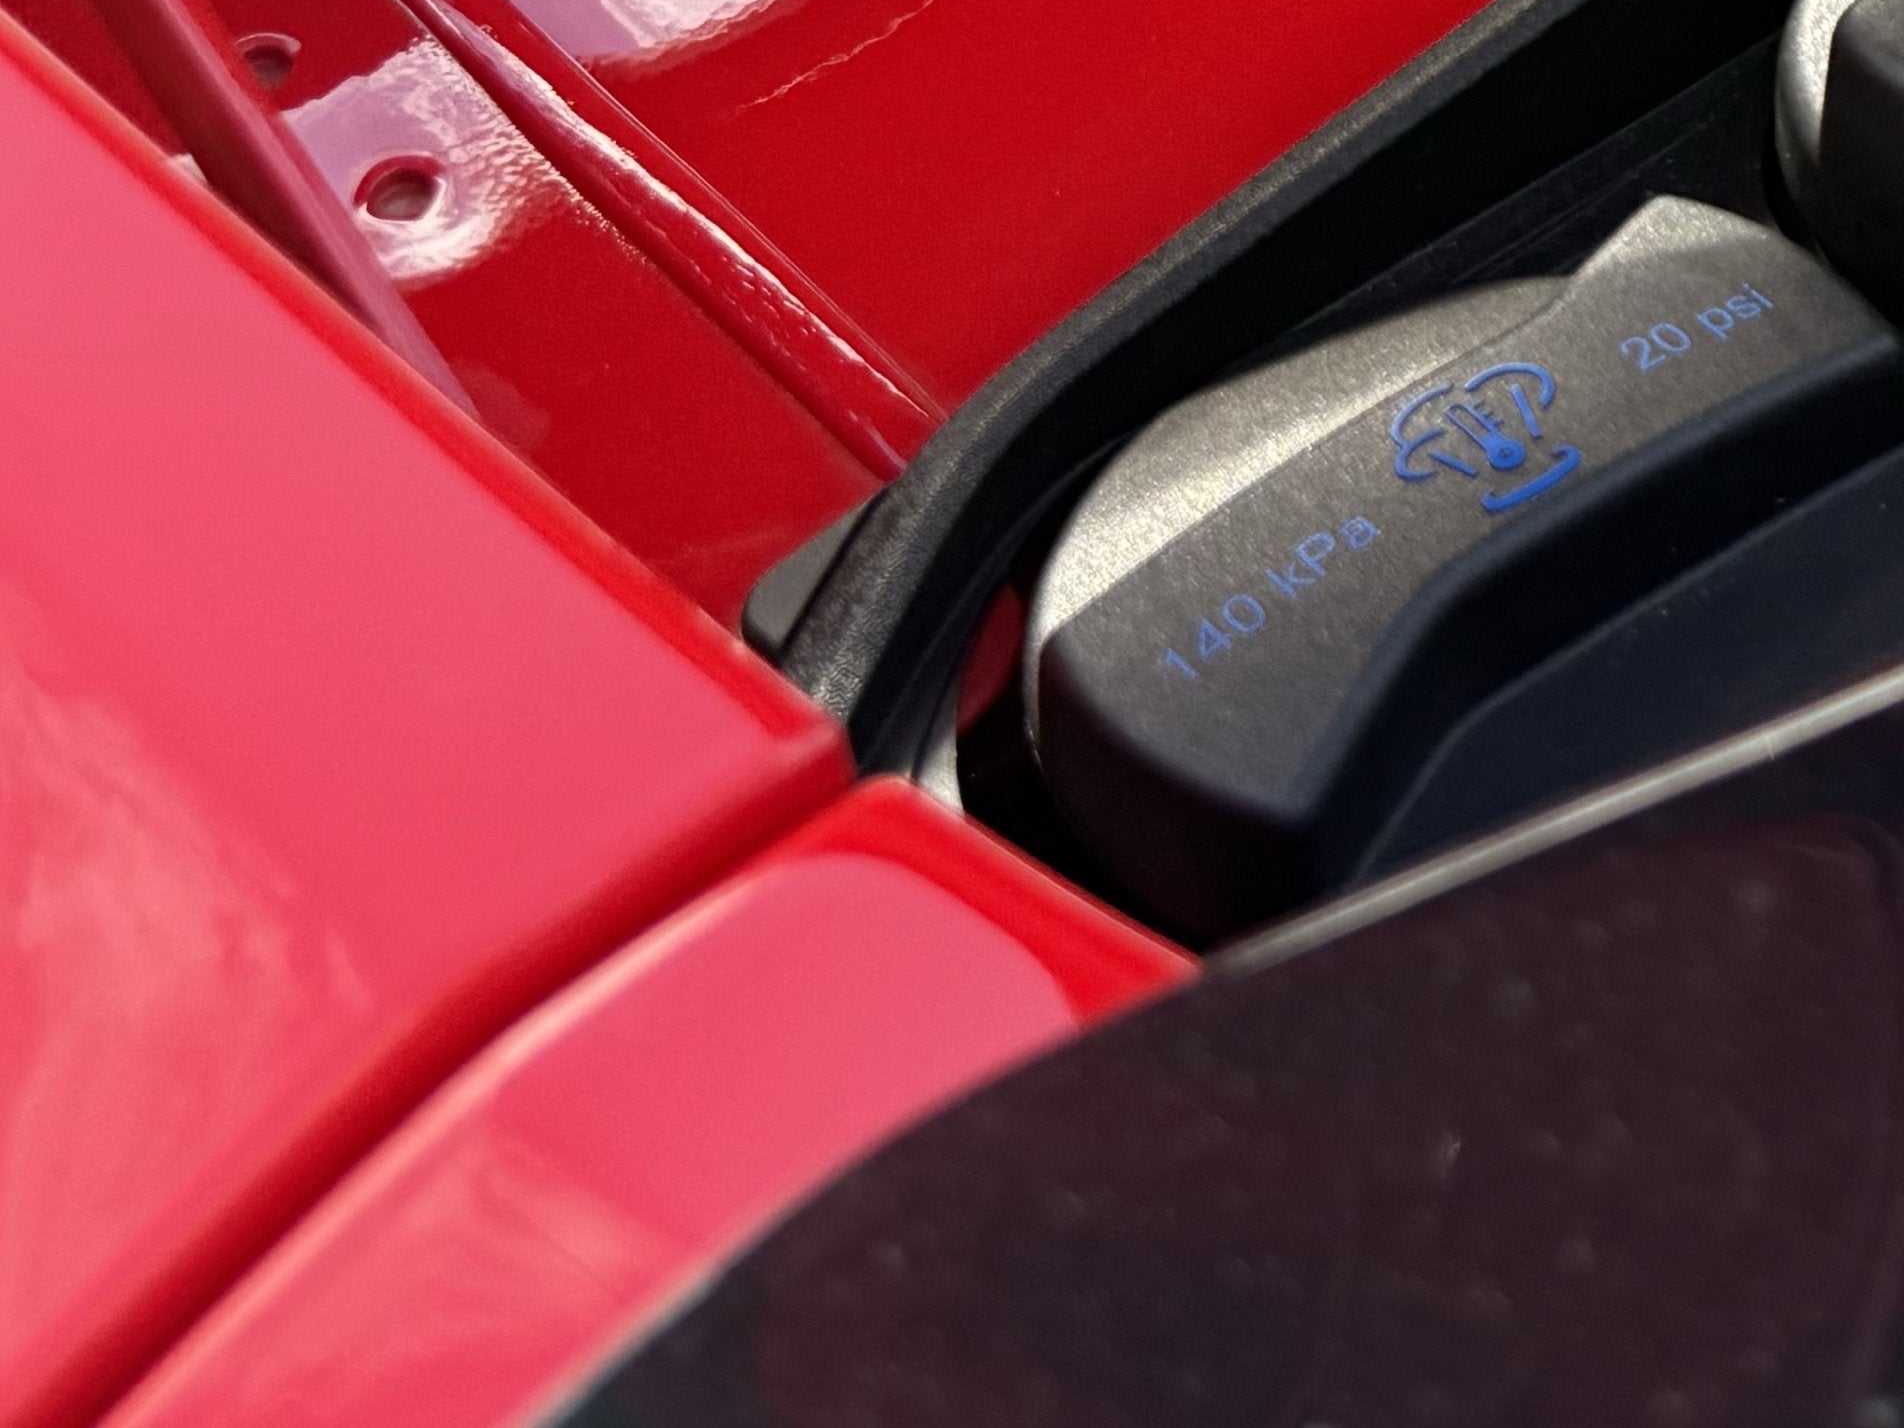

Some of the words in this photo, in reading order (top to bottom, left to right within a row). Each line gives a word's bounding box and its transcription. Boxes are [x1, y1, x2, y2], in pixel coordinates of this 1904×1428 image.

[1158, 594, 1268, 683] 140
[1264, 514, 1384, 602] kPa
[1617, 320, 1696, 375] 20
[1694, 282, 1776, 345] psi
